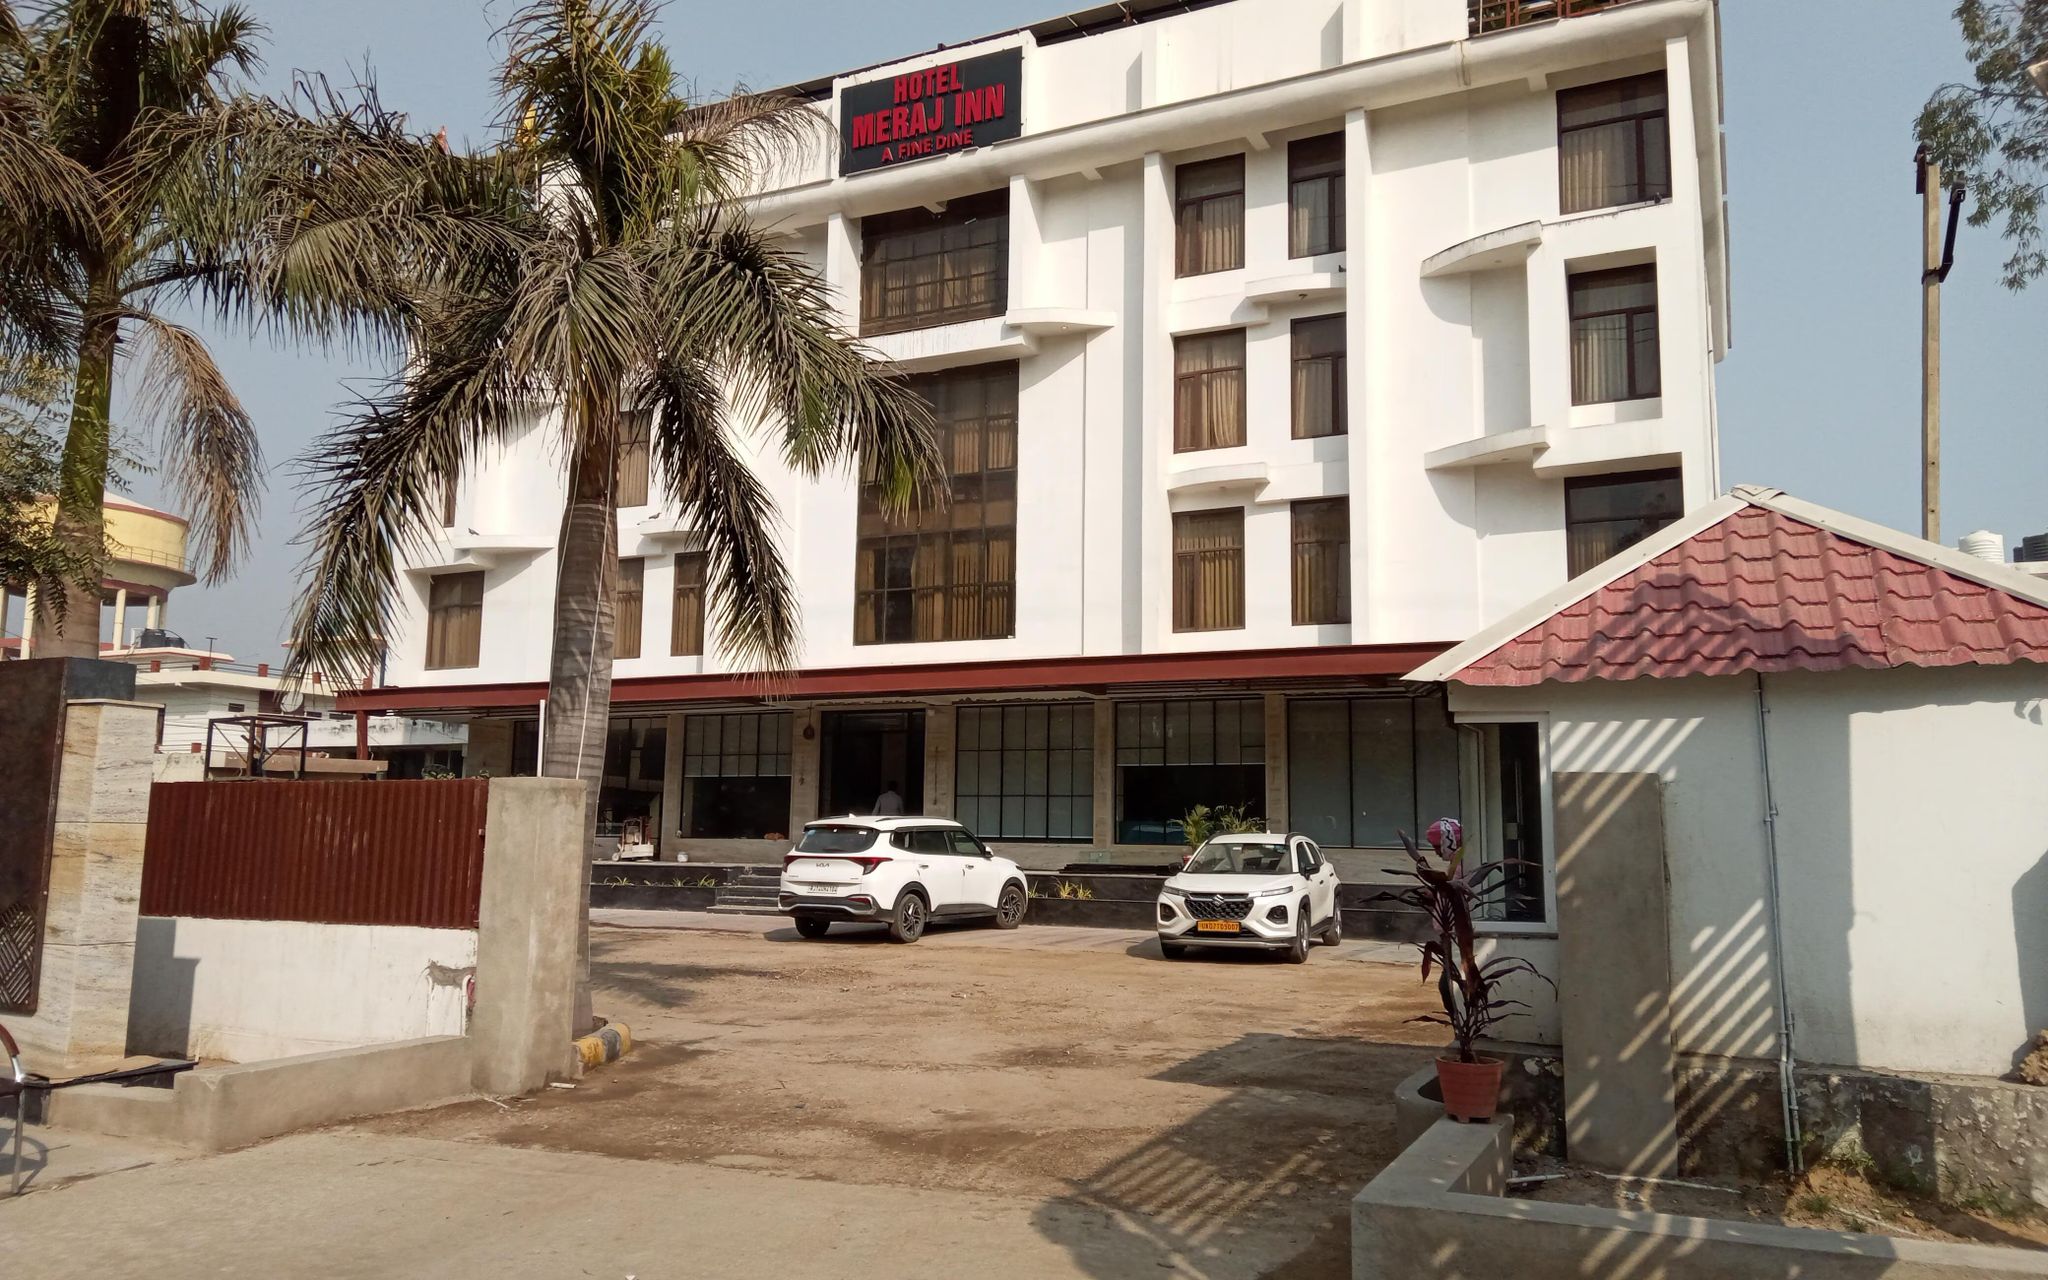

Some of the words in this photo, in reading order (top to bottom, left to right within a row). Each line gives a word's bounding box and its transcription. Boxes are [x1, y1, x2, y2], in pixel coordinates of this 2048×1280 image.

[893, 63, 963, 105] HOTEL
[852, 97, 945, 150] MERAJ
[954, 82, 1006, 127] INN
[881, 146, 894, 162] A
[899, 137, 934, 160] FINE
[935, 129, 973, 151] DINE
